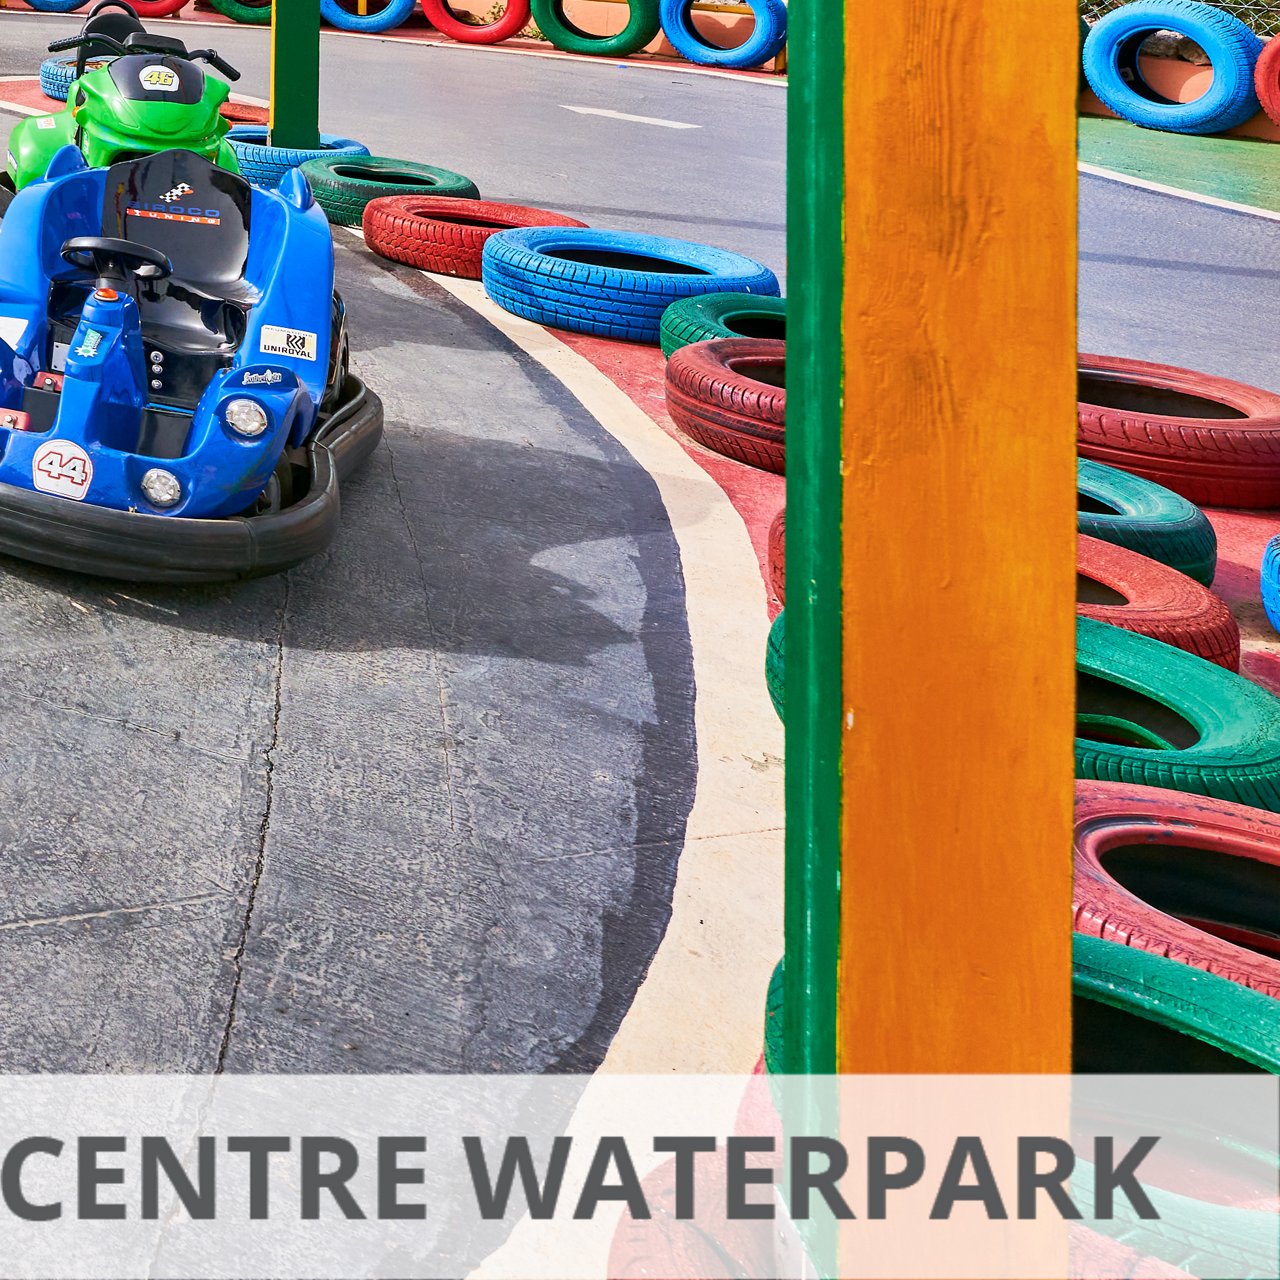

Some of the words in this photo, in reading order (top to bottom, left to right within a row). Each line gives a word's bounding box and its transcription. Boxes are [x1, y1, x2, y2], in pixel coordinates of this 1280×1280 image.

[142, 70, 174, 87] 46
[263, 344, 313, 359] UNIROYAL
[37, 450, 88, 486] 44
